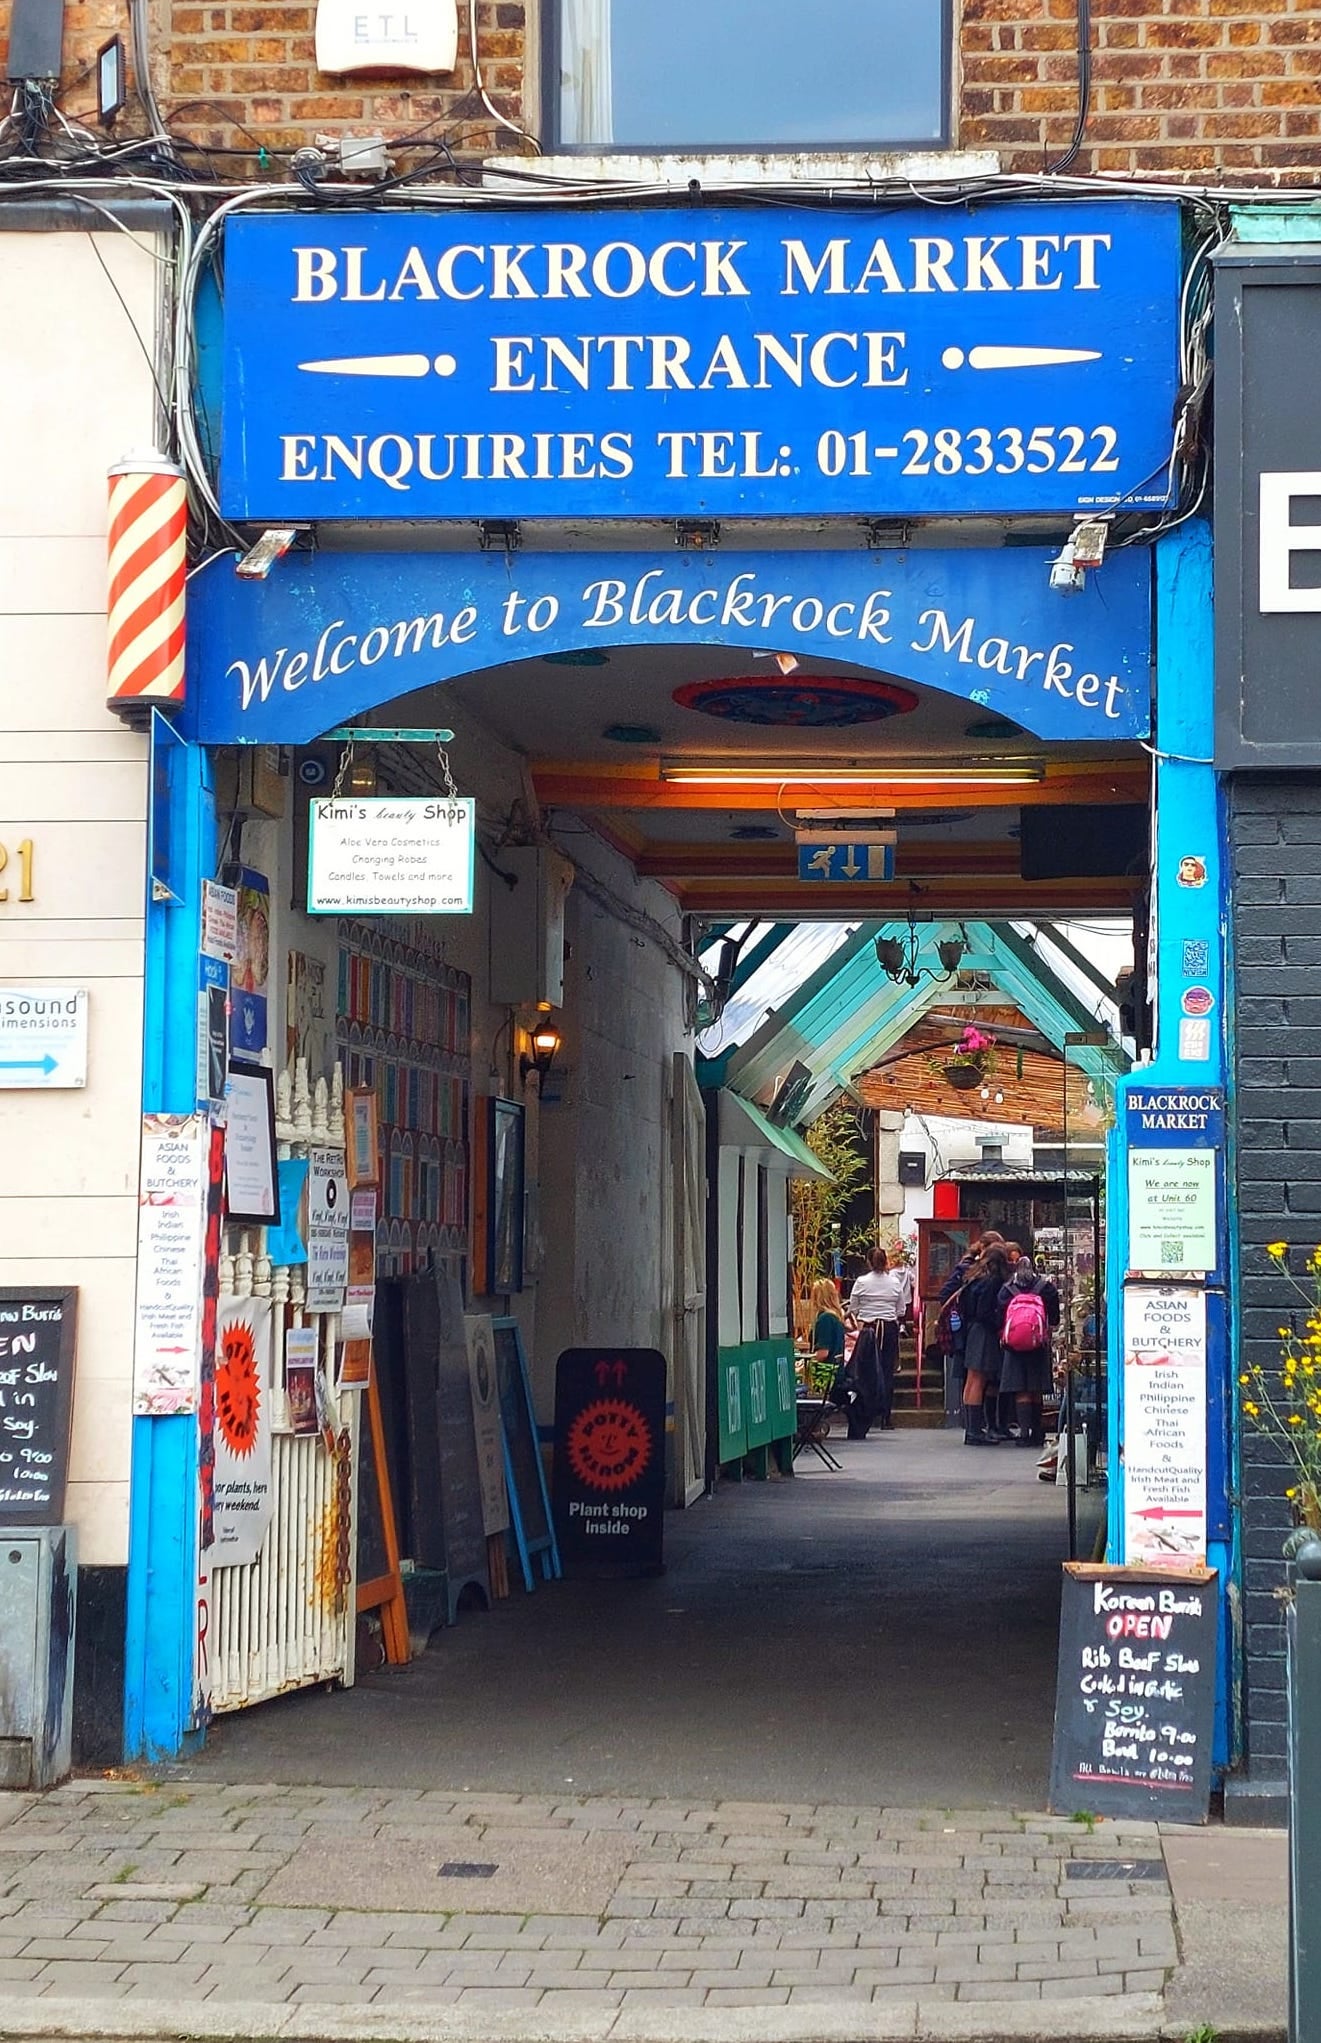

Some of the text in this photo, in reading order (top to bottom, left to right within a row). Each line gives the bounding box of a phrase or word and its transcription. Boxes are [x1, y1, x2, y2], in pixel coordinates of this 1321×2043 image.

[292, 233, 1112, 303] BLACKROCK MARKET
[489, 331, 909, 393] ENTRANCE
[279, 426, 1120, 489] ENQUIRIES TEL: 01-2833522
[225, 569, 1126, 718] Welcome to Blackrock Market
[318, 804, 367, 820] Kimi's
[424, 804, 466, 824] Shop
[340, 837, 441, 847] Aloe Vera Cosmetics
[352, 854, 428, 866] Changing Robes
[372, 871, 406, 881] Towels
[408, 871, 426, 881] and
[428, 873, 453, 881] more
[1128, 1095, 1221, 1111] BLACKROCK
[1141, 1113, 1209, 1129] MARKET
[158, 1142, 189, 1151] ASIAN
[156, 1154, 192, 1164] FOODS
[1133, 1157, 1160, 1166] Kimi's
[1187, 1157, 1211, 1168] Shop
[147, 1178, 198, 1188] BUTCHERY
[1145, 1179, 1160, 1188] We
[1161, 1194, 1181, 1202] Unit
[1146, 1301, 1188, 1311] ASIAN
[1144, 1313, 1192, 1323] FOODS
[1160, 1325, 1171, 1335] &
[1132, 1337, 1202, 1348] BUTCHERY
[1155, 1370, 1179, 1378] Irish
[1149, 1381, 1184, 1389] Indian
[1139, 1393, 1196, 1403] Philippine
[1144, 1406, 1189, 1415] Chinese
[1156, 1418, 1179, 1427] Thai
[1145, 1428, 1186, 1437] African
[1150, 1440, 1184, 1448] Foods
[1154, 1475, 1179, 1483] Meat
[1182, 1475, 1200, 1484] and
[1146, 1495, 1190, 1503] Available
[569, 1502, 648, 1520] Plant shop
[1107, 1614, 1173, 1641] OPEN
[1082, 1645, 1112, 1669] Rib
[1149, 1748, 1194, 1766] 10.00
